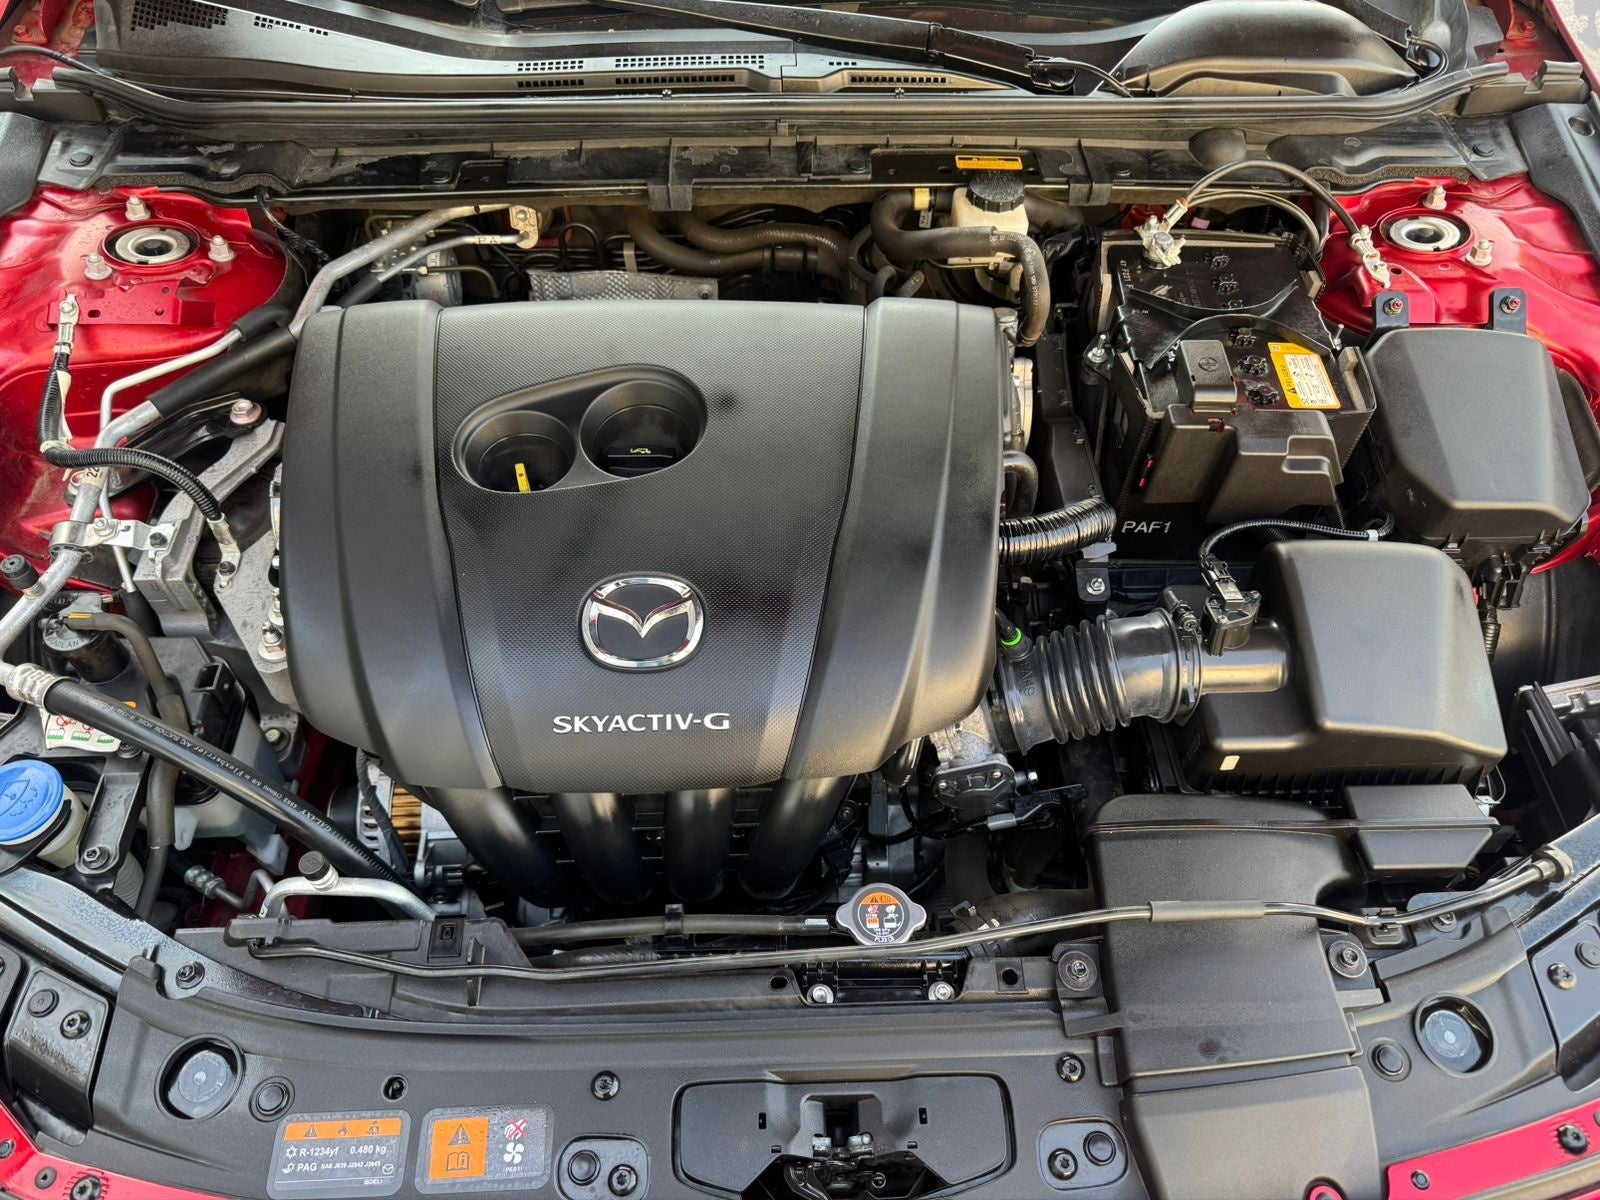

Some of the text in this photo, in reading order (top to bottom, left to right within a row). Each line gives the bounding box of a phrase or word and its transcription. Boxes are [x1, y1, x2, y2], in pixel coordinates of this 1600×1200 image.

[1121, 520, 1172, 534] PAF1
[552, 712, 730, 734] SKYACTIV-G
[152, 724, 180, 742] SUCTION
[193, 745, 244, 776] Flexbarrier
[300, 809, 332, 832] GALAXY
[299, 1144, 387, 1157] R-1234yf 0.480 kg
[297, 1162, 317, 1172] PAG
